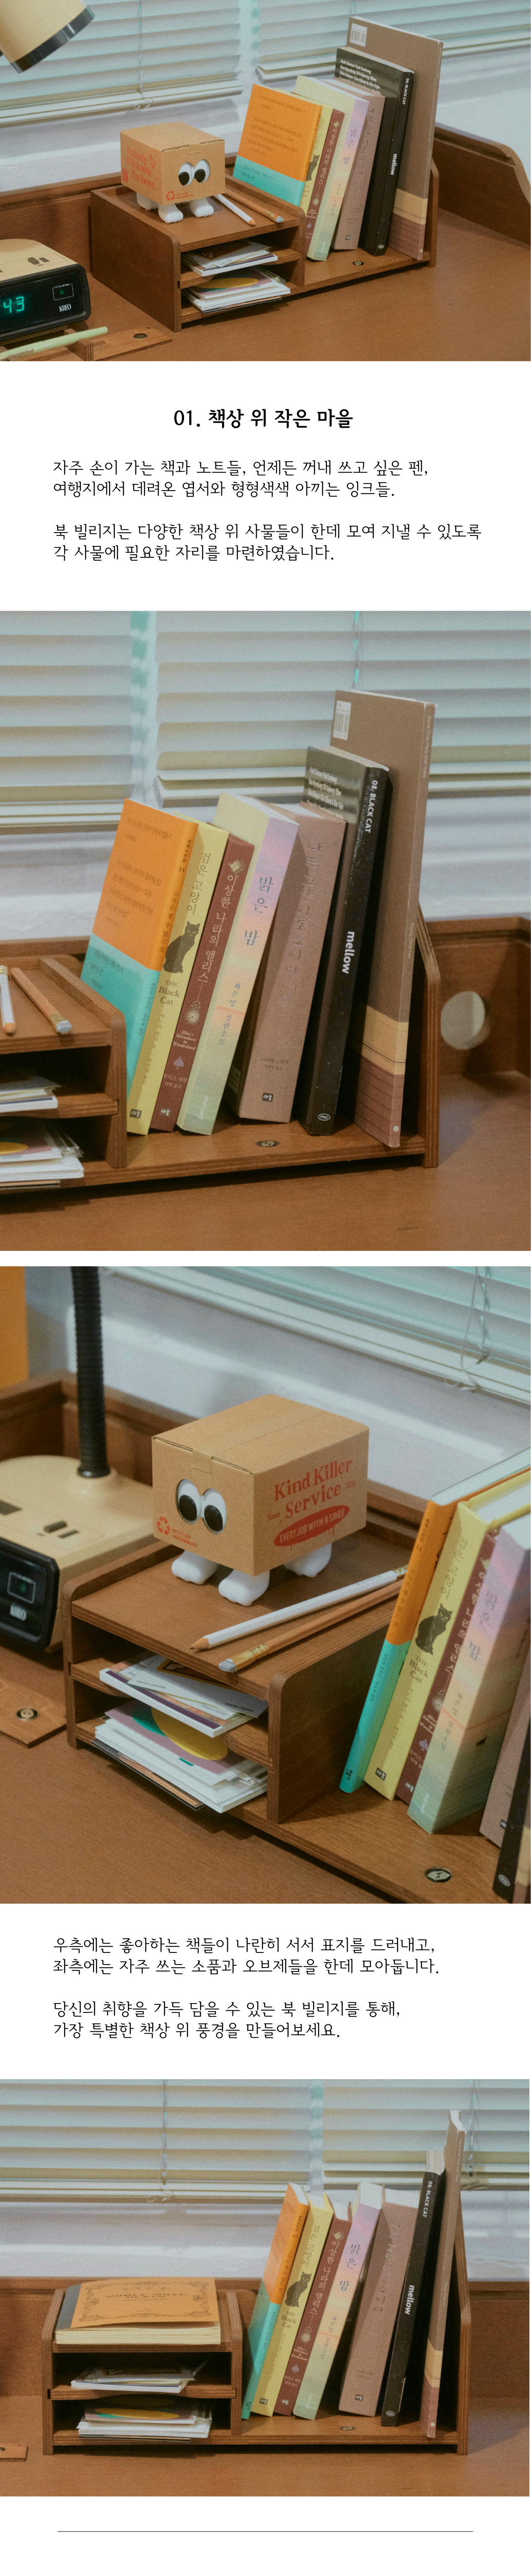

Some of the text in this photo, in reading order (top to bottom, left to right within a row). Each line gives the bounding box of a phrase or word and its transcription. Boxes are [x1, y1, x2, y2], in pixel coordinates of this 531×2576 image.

[127, 146, 147, 165] Nobody
[318, 128, 338, 184] 이상한 나라의 앨리스
[343, 129, 357, 165] 밝은 밤
[132, 169, 157, 190] I'm here.
[137, 161, 152, 177] know
[59, 304, 72, 312] KREO
[187, 853, 211, 915] 검은 고양이
[244, 876, 274, 946] 밝은 밤
[198, 875, 238, 982] 이상한 나라의 앨리스
[342, 931, 355, 974] mellow
[158, 986, 180, 998] Black
[161, 996, 174, 1006] Cat
[229, 983, 241, 1007] 최은영
[176, 1033, 197, 1042] Adventures
[218, 1014, 232, 1046] 장편소설
[173, 1041, 197, 1050] Wonderland
[163, 1073, 176, 1081] 루이스
[274, 1459, 352, 1501] Kind Killer
[268, 1512, 280, 1521] Since
[286, 1484, 341, 1519] Service
[280, 1508, 345, 1543] EVERY JOB WITH A SMILE
[441, 1565, 458, 1599] 고양이
[409, 1659, 429, 1679] Black
[416, 1655, 428, 1667] THE
[410, 1671, 423, 1684] Cat
[302, 2225, 320, 2268] 검은 고양이
[310, 2241, 340, 2315] 이상한 나라의 앨리스
[339, 2244, 361, 2291] 밝은 밤
[405, 2285, 414, 2315] mellow
